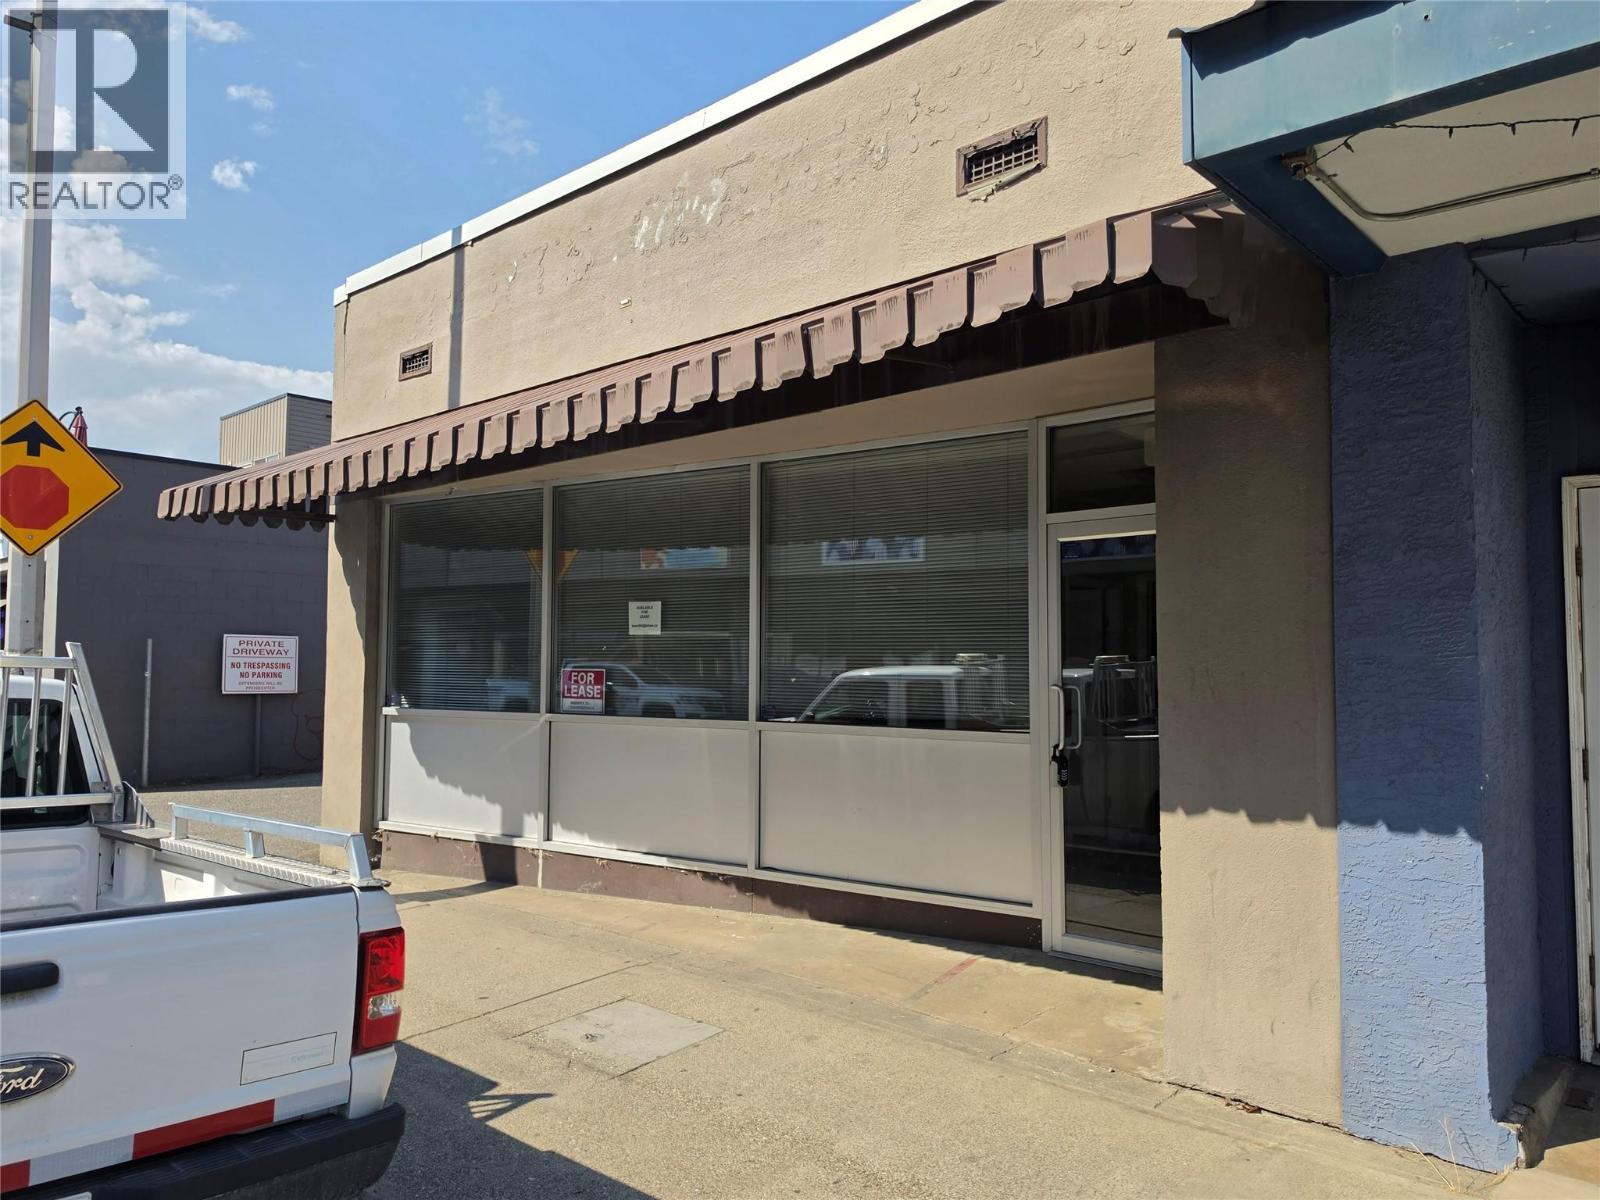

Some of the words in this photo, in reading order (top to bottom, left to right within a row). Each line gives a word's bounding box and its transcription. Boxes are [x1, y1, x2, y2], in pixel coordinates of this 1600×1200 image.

[238, 640, 285, 648] PRIVATE
[232, 648, 289, 656] DRIVEWAY
[571, 672, 595, 685] FOR
[564, 685, 601, 698] LEASE
